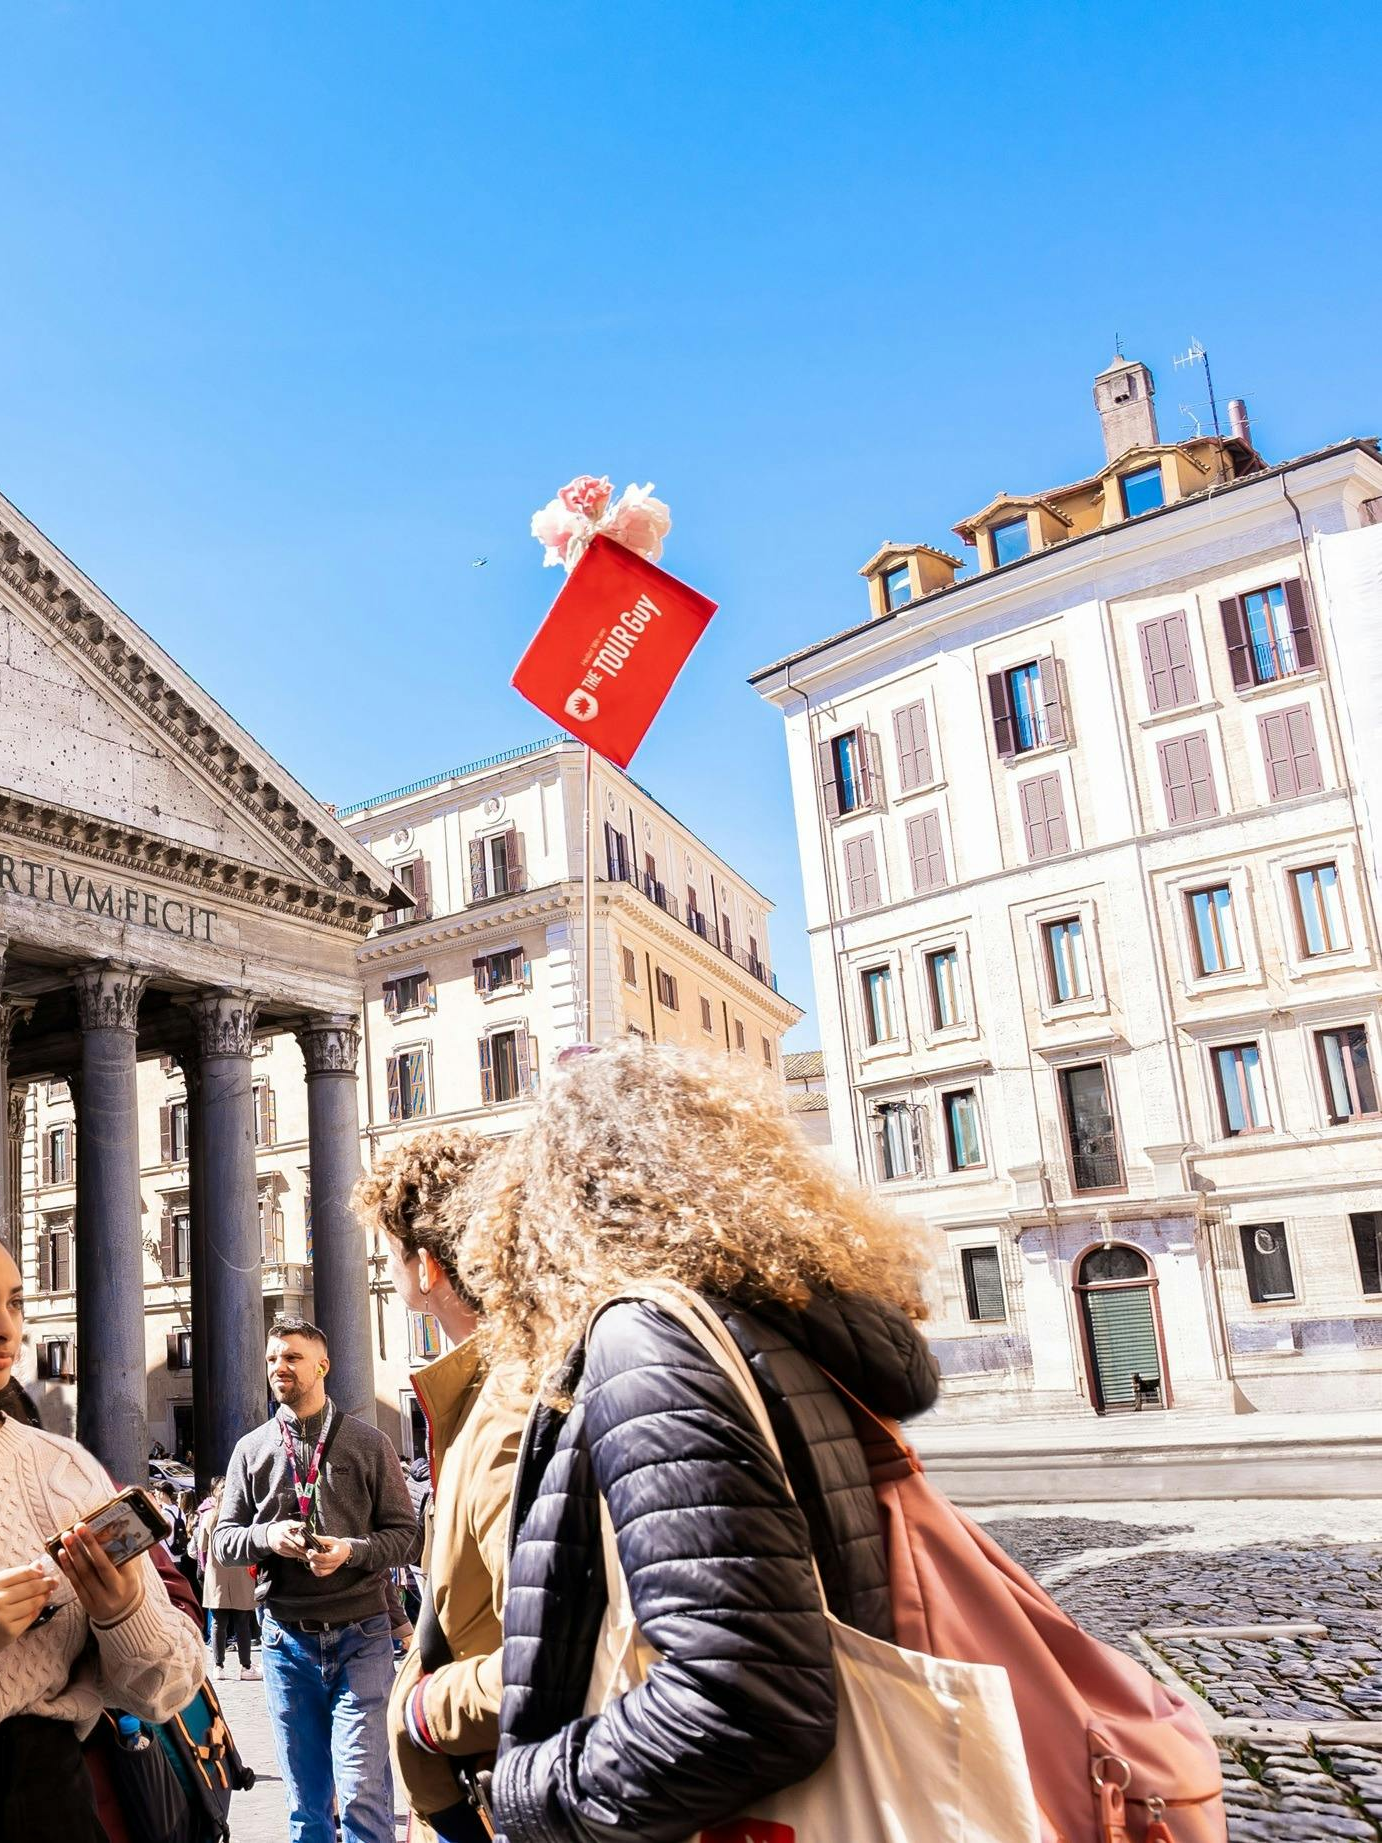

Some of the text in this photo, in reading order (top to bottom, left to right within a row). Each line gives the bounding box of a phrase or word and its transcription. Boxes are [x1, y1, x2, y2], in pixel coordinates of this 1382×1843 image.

[581, 668, 603, 692] THE
[592, 624, 639, 678] TOUR
[619, 593, 662, 634] GUY
